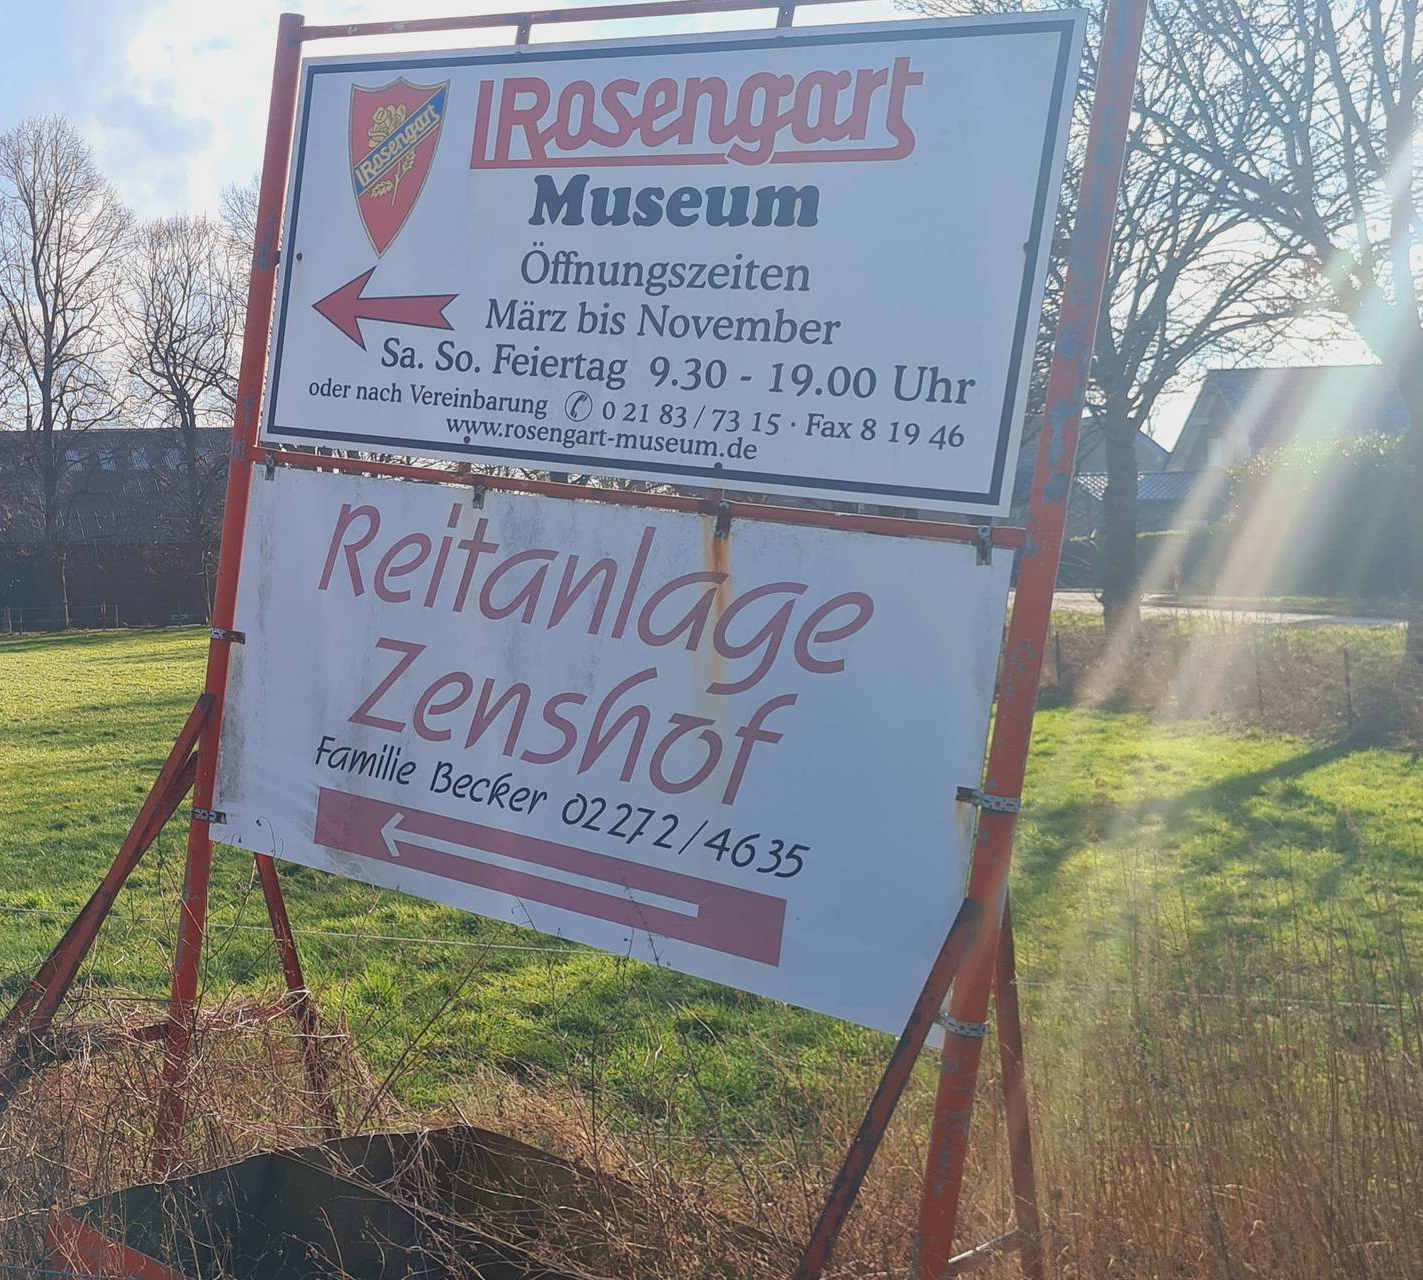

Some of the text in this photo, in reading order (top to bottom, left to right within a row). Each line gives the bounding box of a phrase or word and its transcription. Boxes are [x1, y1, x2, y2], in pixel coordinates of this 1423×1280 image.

[528, 174, 820, 227] Museum
[520, 241, 810, 296] Öffnungszeiten
[485, 298, 841, 345] März bis November
[380, 337, 424, 370] Sa.
[434, 340, 481, 374] So.
[492, 343, 628, 391] Feiertag
[649, 356, 727, 391] 9.30
[768, 362, 877, 398] 19.00
[893, 364, 976, 405] Uhr
[308, 378, 352, 399] oder
[355, 383, 403, 404] nach
[409, 384, 548, 420] Vereinbarung
[601, 401, 616, 421] 0
[622, 402, 650, 424] 21
[751, 411, 782, 436] 15
[804, 413, 853, 440] Fax
[860, 418, 878, 441] 8
[888, 420, 921, 447] 19
[928, 424, 966, 451] 46
[445, 416, 758, 461] www.rosengart-museum.de
[318, 502, 874, 696] Reitanlage
[348, 636, 798, 806] Zenshof
[314, 736, 812, 879] Familie Becker 02272/4635
